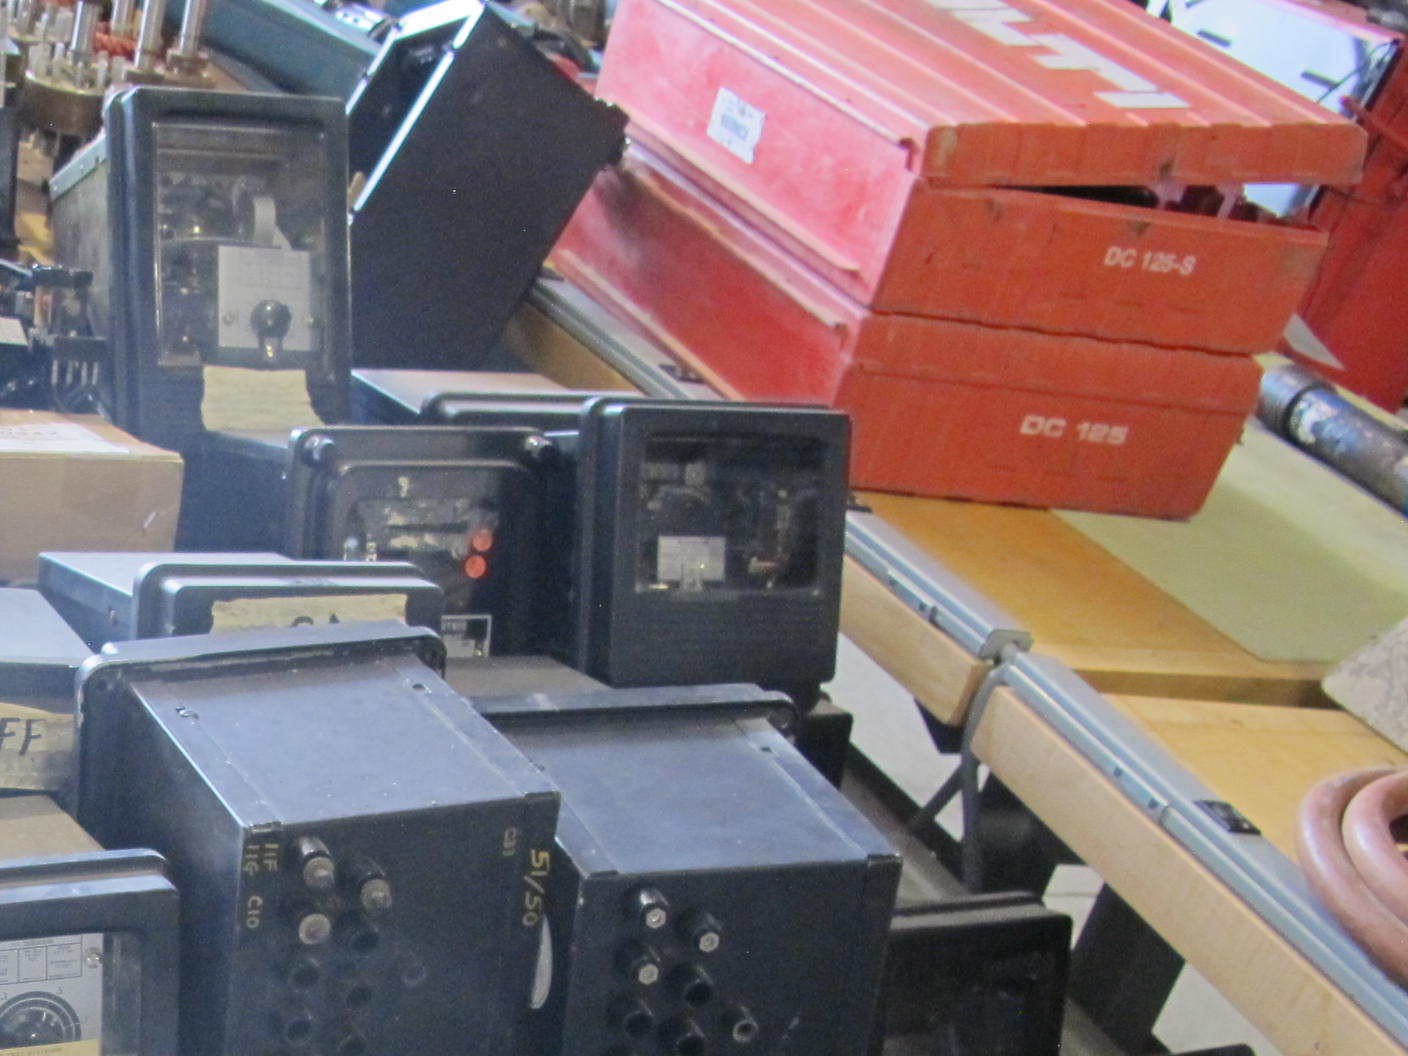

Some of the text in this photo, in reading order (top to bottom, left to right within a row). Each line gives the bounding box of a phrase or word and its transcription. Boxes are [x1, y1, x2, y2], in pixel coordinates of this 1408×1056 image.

[1104, 246, 1197, 276] DC 125-S
[1020, 414, 1130, 445] DC 125
